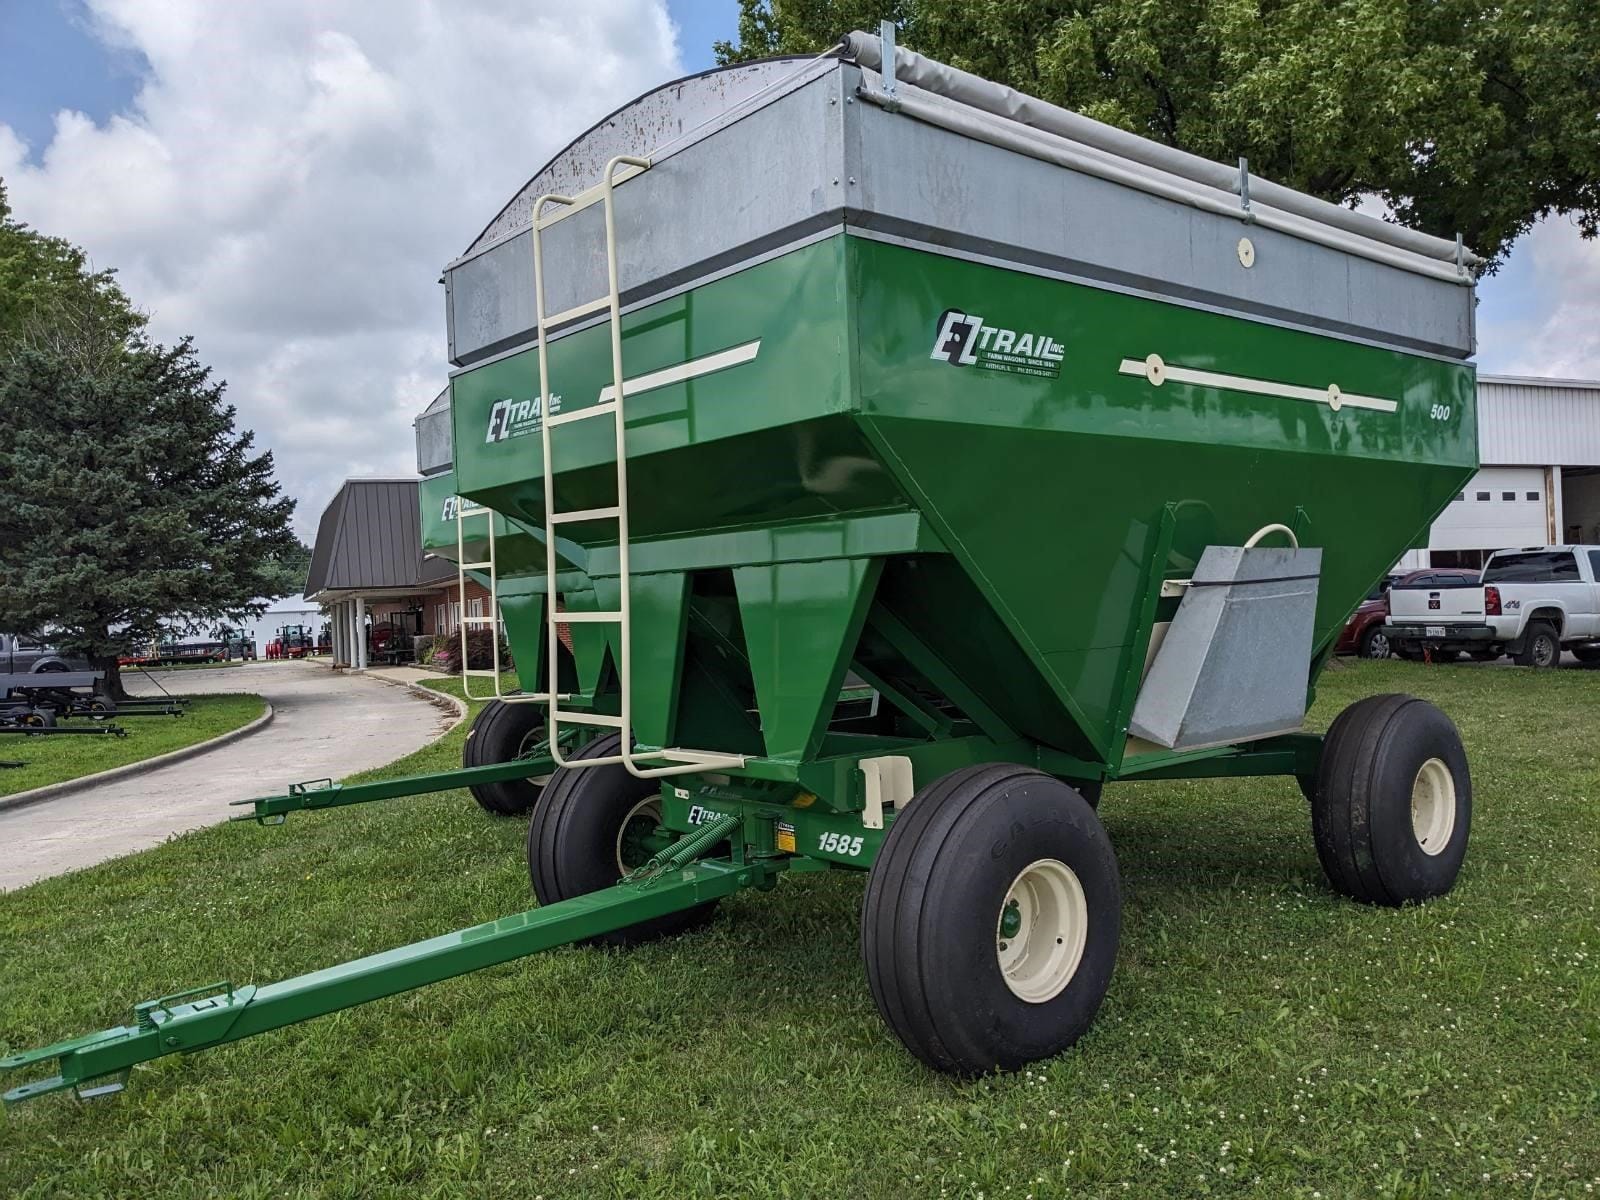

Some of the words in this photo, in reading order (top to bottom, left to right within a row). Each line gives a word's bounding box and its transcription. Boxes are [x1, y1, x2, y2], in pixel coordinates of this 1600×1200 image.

[979, 326, 1064, 361] TRAIL
[1430, 404, 1450, 421] 500
[818, 832, 864, 857] 1585
